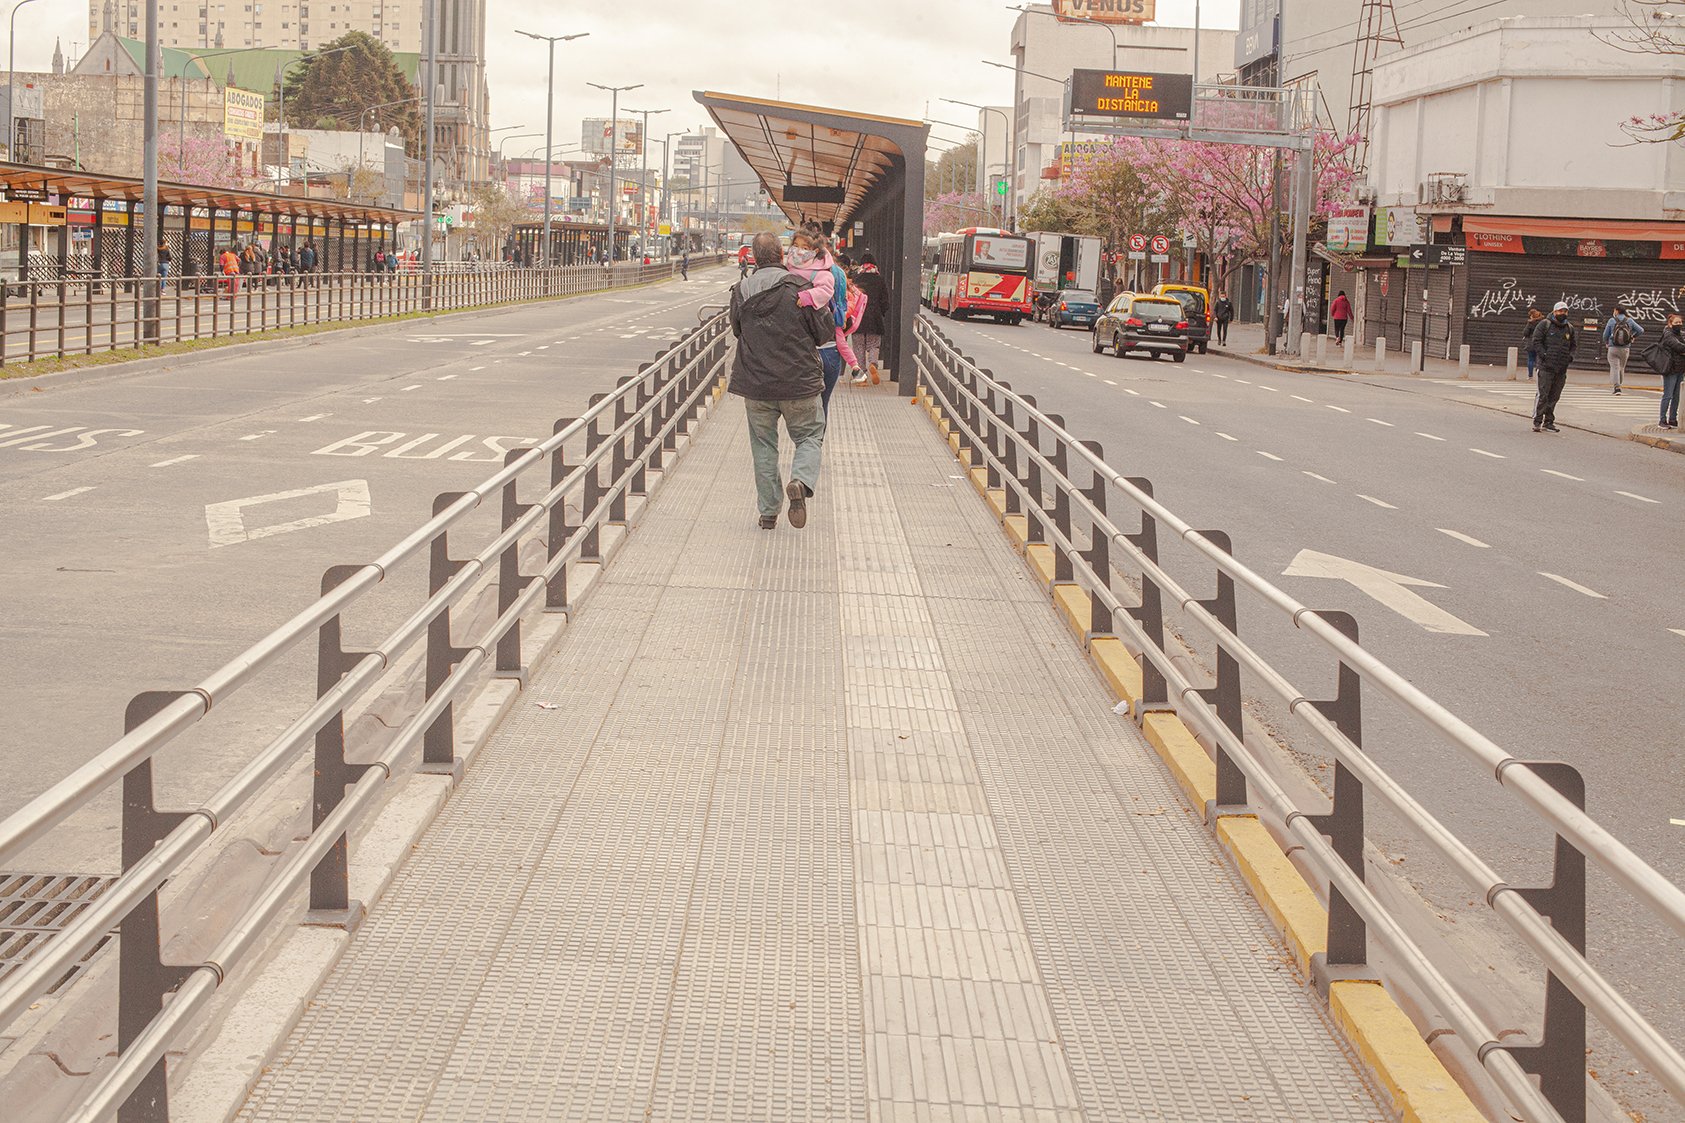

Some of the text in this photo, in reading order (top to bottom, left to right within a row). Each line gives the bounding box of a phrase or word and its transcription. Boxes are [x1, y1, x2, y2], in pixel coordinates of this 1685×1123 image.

[1072, 0, 1144, 13] VENUS
[1105, 75, 1153, 89] MANTENE
[227, 92, 263, 110] ABOGADOS
[1124, 88, 1138, 100] LA
[1097, 98, 1158, 113] DISTANCIA
[1473, 233, 1513, 242] CLOTHING
[0, 423, 145, 452] US
[310, 431, 540, 463] BUS
